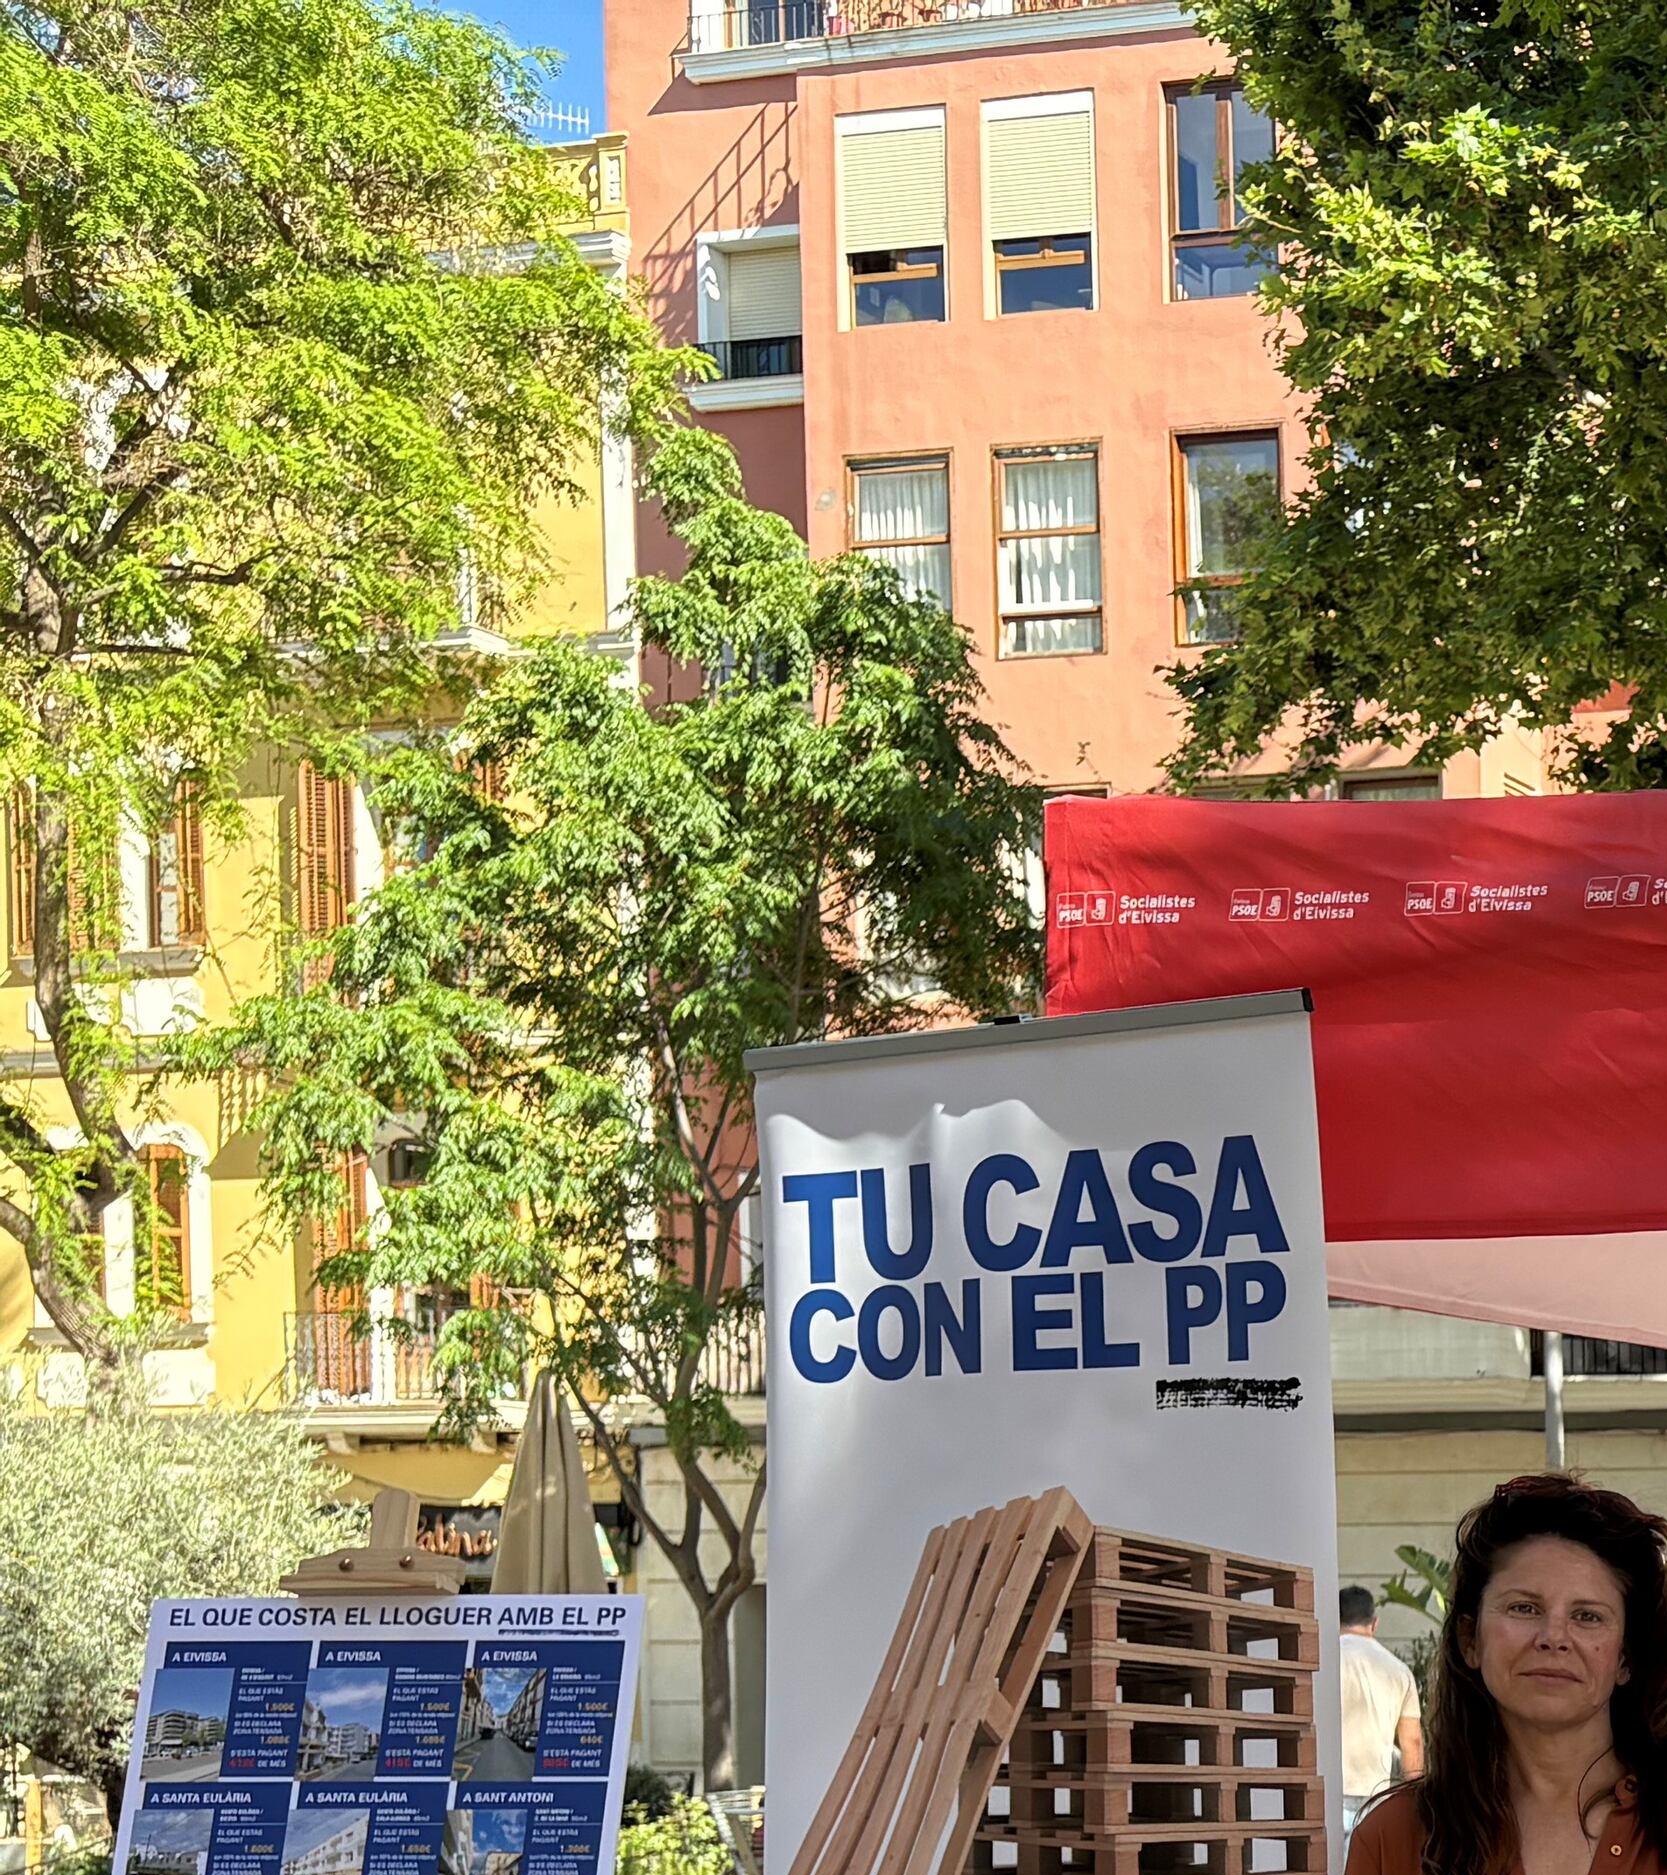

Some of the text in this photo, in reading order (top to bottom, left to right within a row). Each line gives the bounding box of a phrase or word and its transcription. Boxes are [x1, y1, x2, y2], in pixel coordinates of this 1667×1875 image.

[1294, 890, 1369, 905] Socialistes
[1470, 883, 1548, 899] Socialistes
[1587, 889, 1613, 903] PSOE
[1120, 894, 1195, 910] Socialistes
[1232, 902, 1259, 916] PSOE
[1407, 897, 1433, 911] PSOE
[1058, 908, 1083, 922] PSOE
[782, 1134, 1290, 1284] TU CASA
[789, 1260, 1287, 1384] CON EL PP
[169, 1607, 626, 1628] EL QUE COSTA EL LLOGUER AMB EL PP
[183, 1652, 227, 1662] EIVISSA
[336, 1652, 381, 1662] EIVISSA
[493, 1652, 538, 1662] EIVISSA
[162, 1793, 200, 1803] SANTA
[317, 1793, 356, 1803] SANTA
[474, 1793, 507, 1803] SANT
